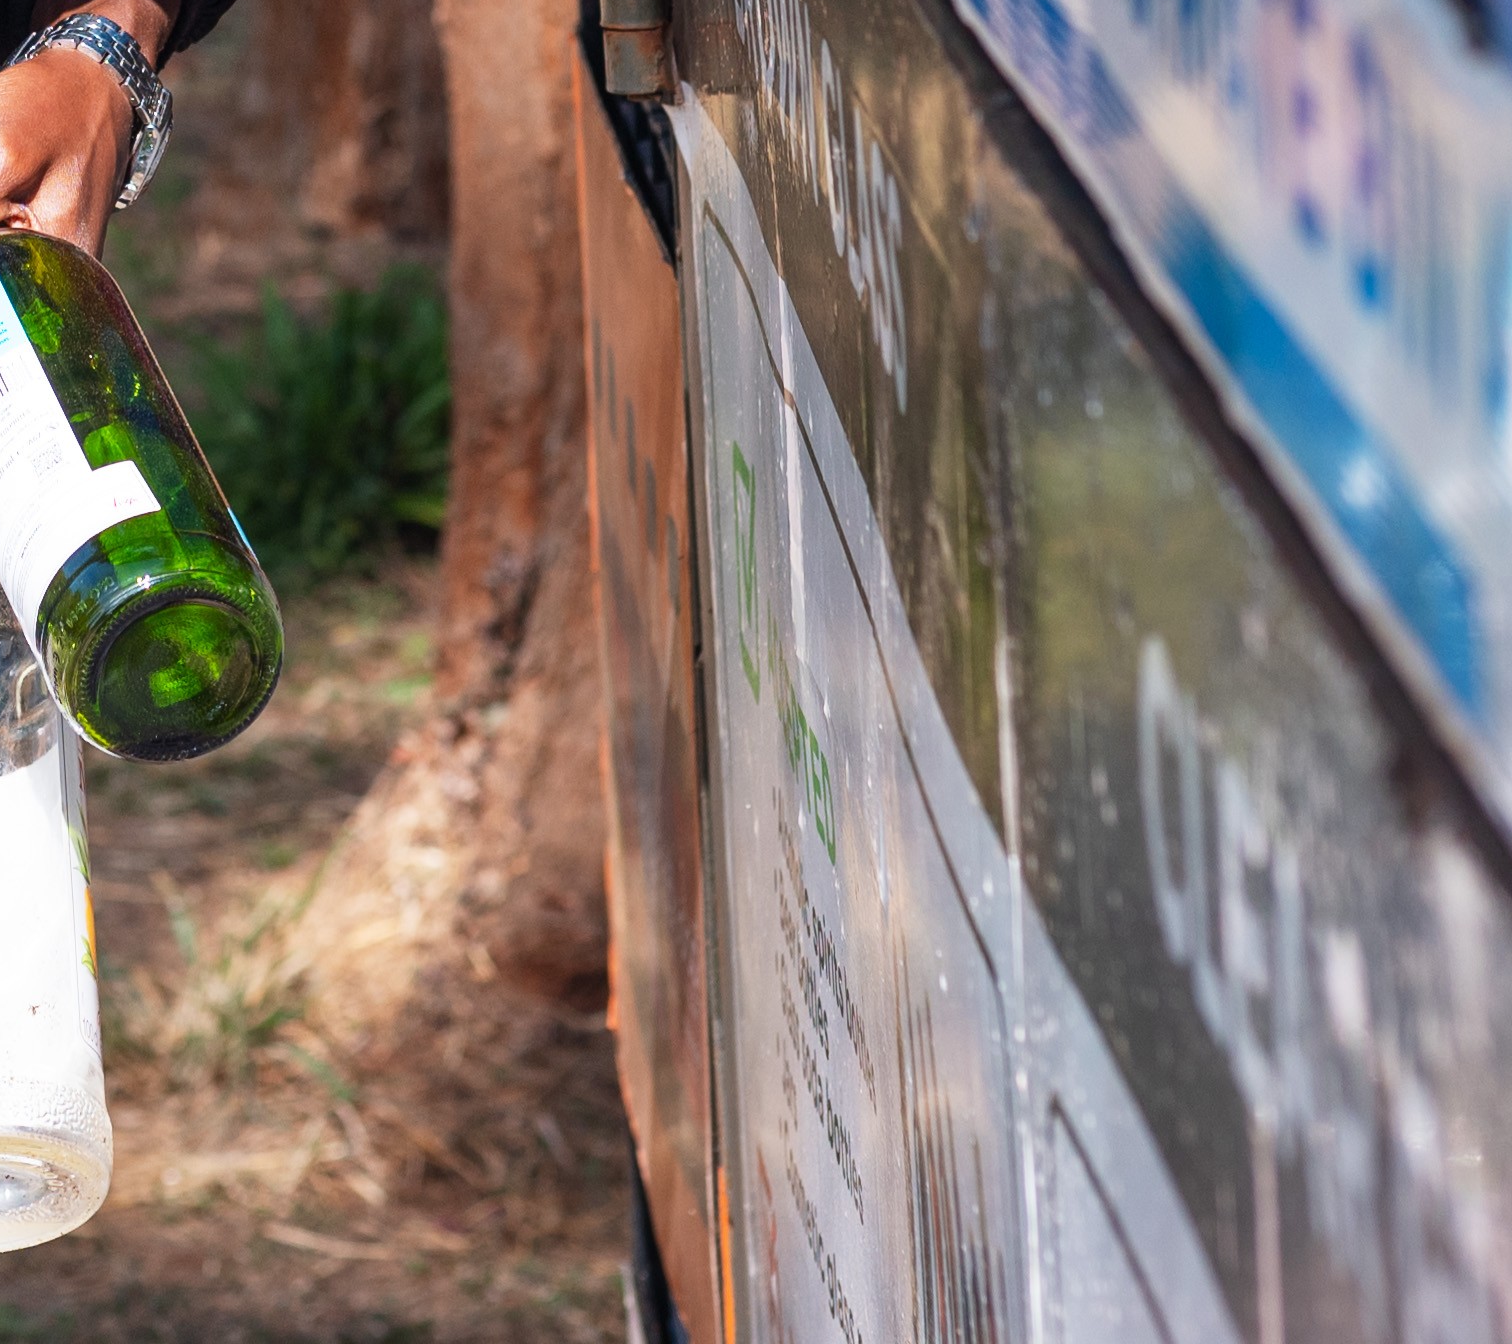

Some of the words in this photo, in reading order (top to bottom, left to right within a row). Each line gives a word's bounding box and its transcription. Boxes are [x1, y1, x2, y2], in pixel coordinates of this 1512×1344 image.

[820, 37, 909, 417] GLASS
[812, 905, 844, 1019] spirits
[825, 1076, 865, 1227] bottles
